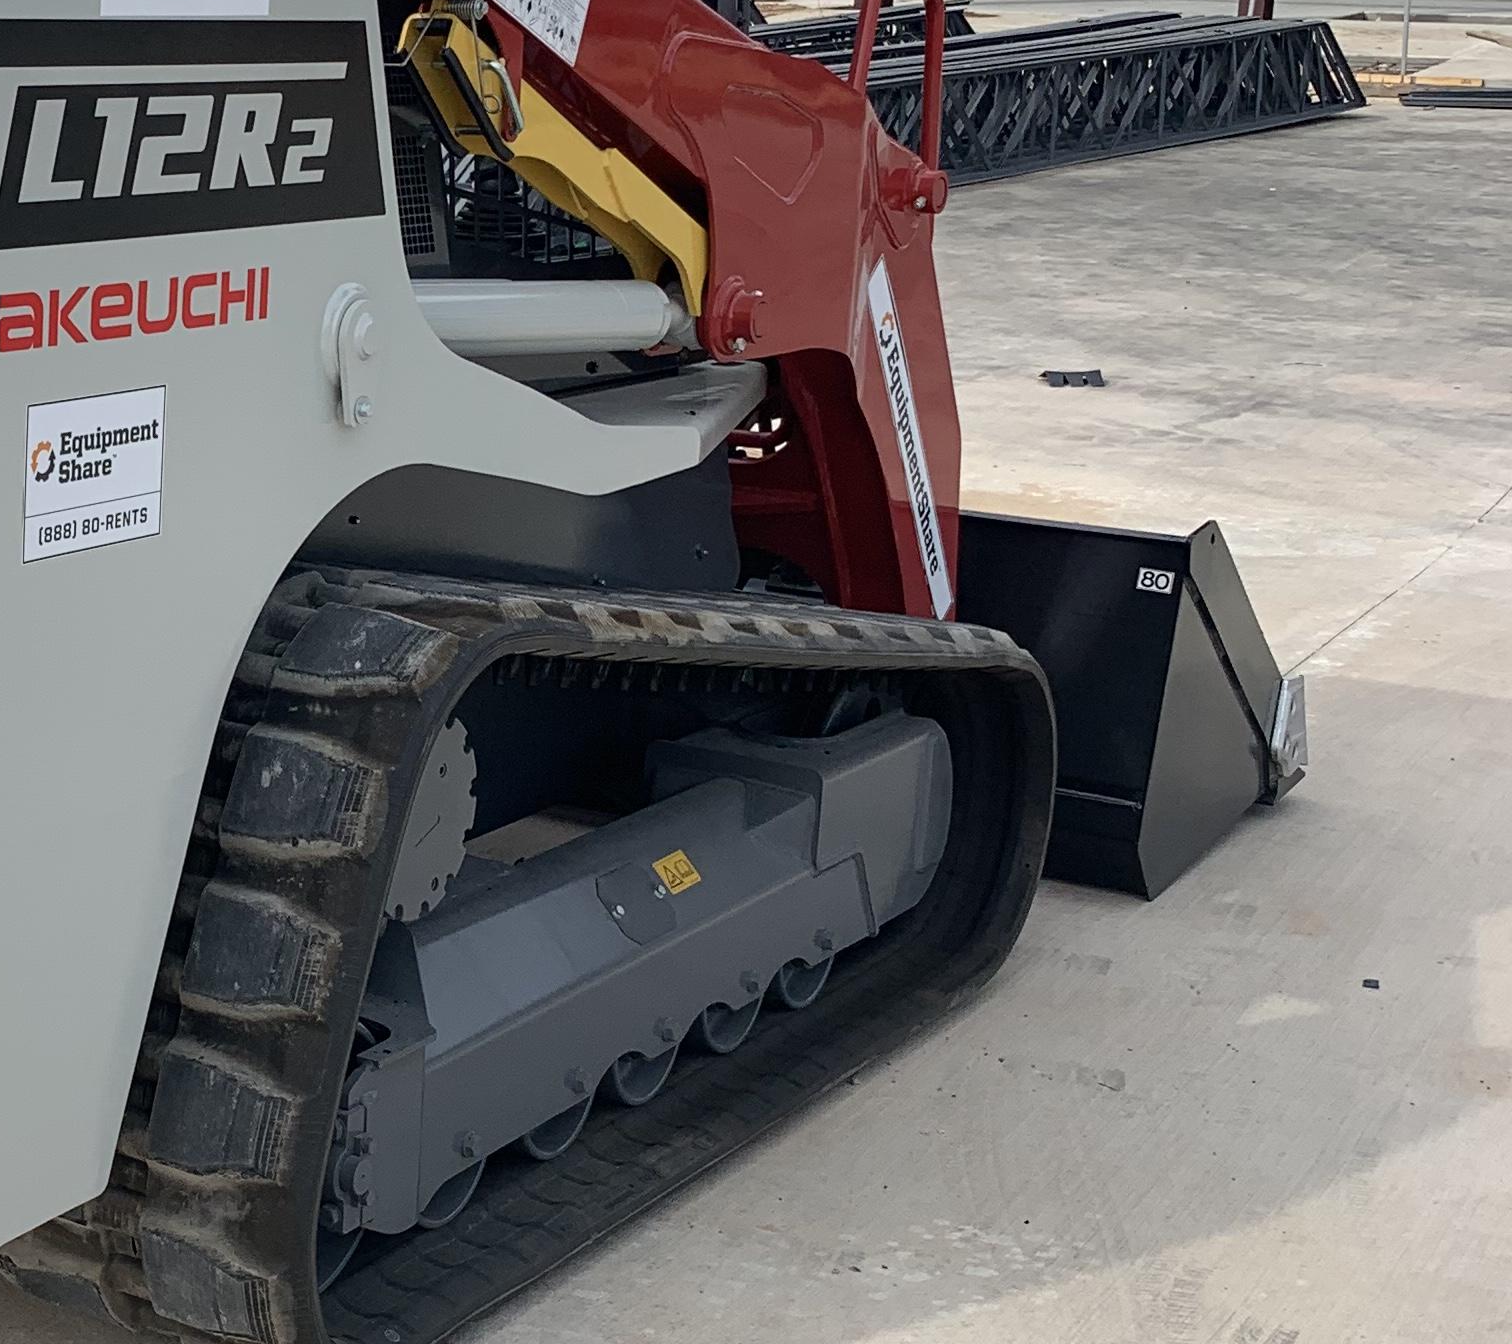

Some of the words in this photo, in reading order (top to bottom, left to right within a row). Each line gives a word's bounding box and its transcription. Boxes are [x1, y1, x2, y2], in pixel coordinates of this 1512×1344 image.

[59, 419, 159, 457] Equipment
[58, 458, 112, 484] Share
[885, 344, 939, 577] EquipmentShare
[38, 520, 77, 546] (888)
[82, 507, 148, 535] 80-RENTS
[1139, 570, 1171, 591] 80
